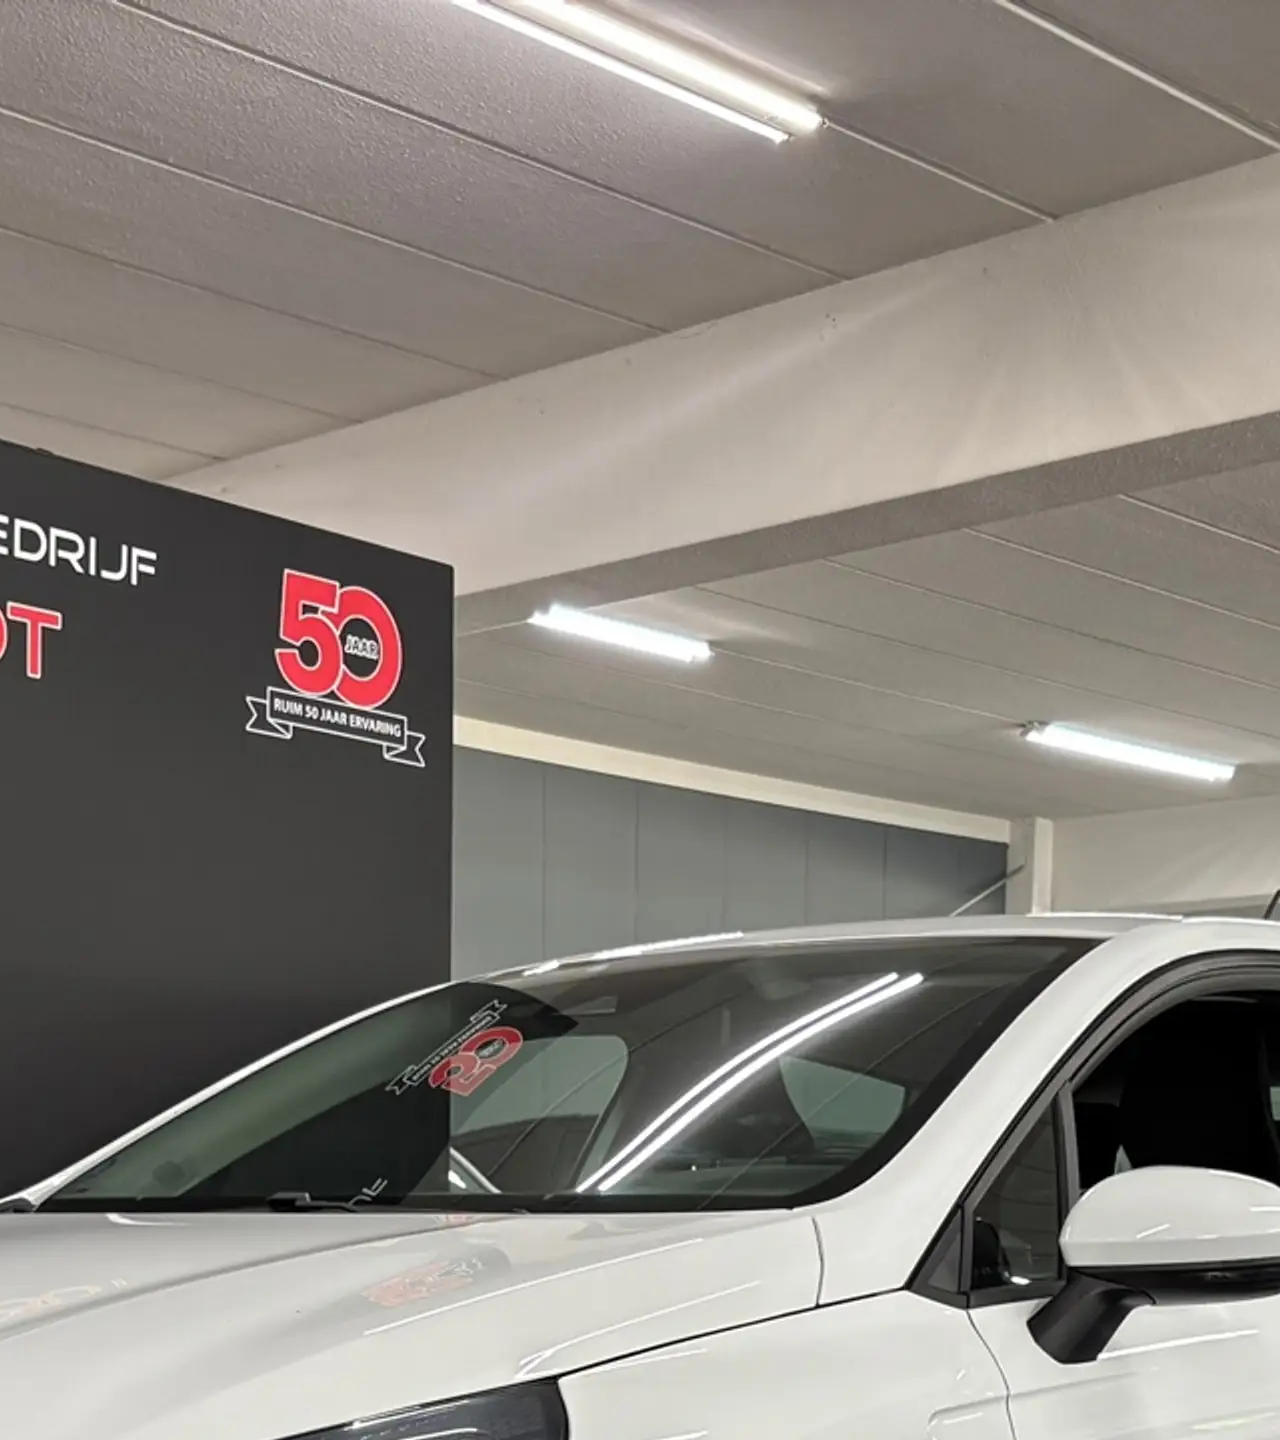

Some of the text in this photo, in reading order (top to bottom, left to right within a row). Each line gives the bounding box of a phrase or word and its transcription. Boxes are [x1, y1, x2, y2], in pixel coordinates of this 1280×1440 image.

[274, 568, 403, 711] 50
[344, 633, 381, 661] JAAR
[273, 698, 402, 738] RUIM 50 JAAR ERVARING
